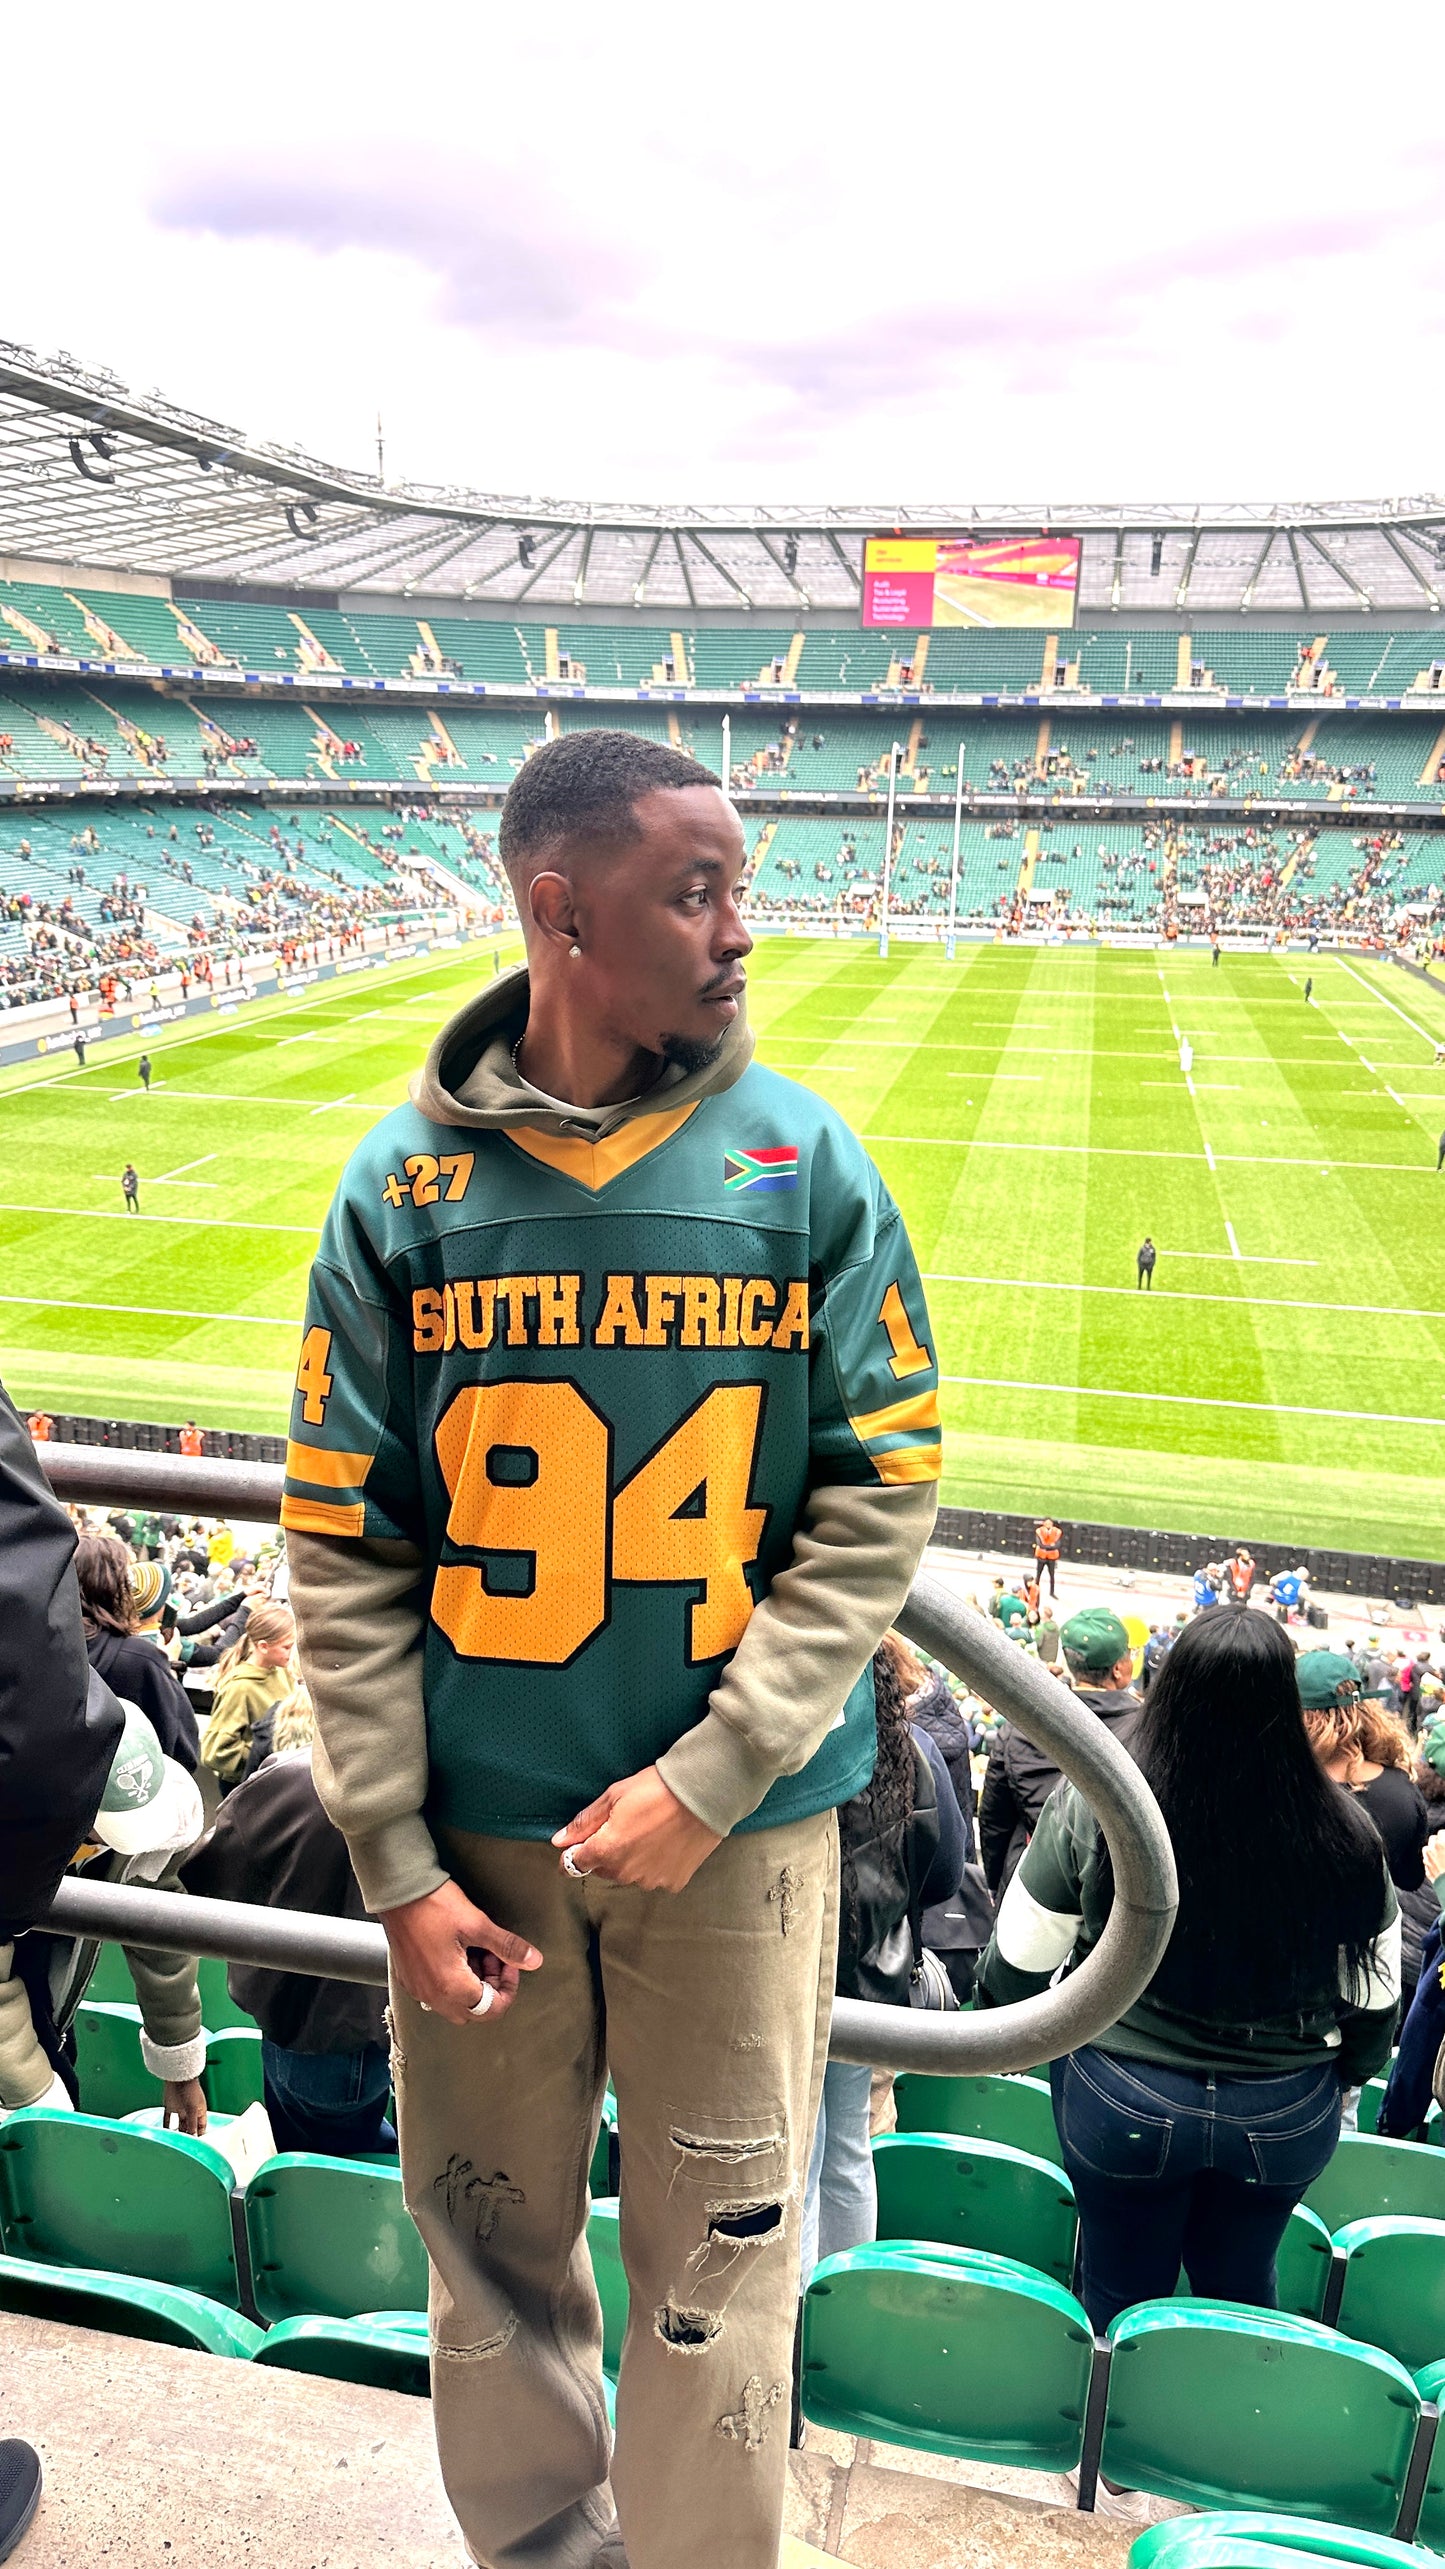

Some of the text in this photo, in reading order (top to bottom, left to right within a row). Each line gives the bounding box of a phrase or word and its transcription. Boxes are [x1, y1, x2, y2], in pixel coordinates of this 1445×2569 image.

[382, 1151, 476, 1209] +27
[410, 1273, 811, 1353] SOUTH AFRICA
[877, 1279, 935, 1382] 1
[297, 1324, 334, 1427] 4
[430, 1376, 770, 1669] 94
